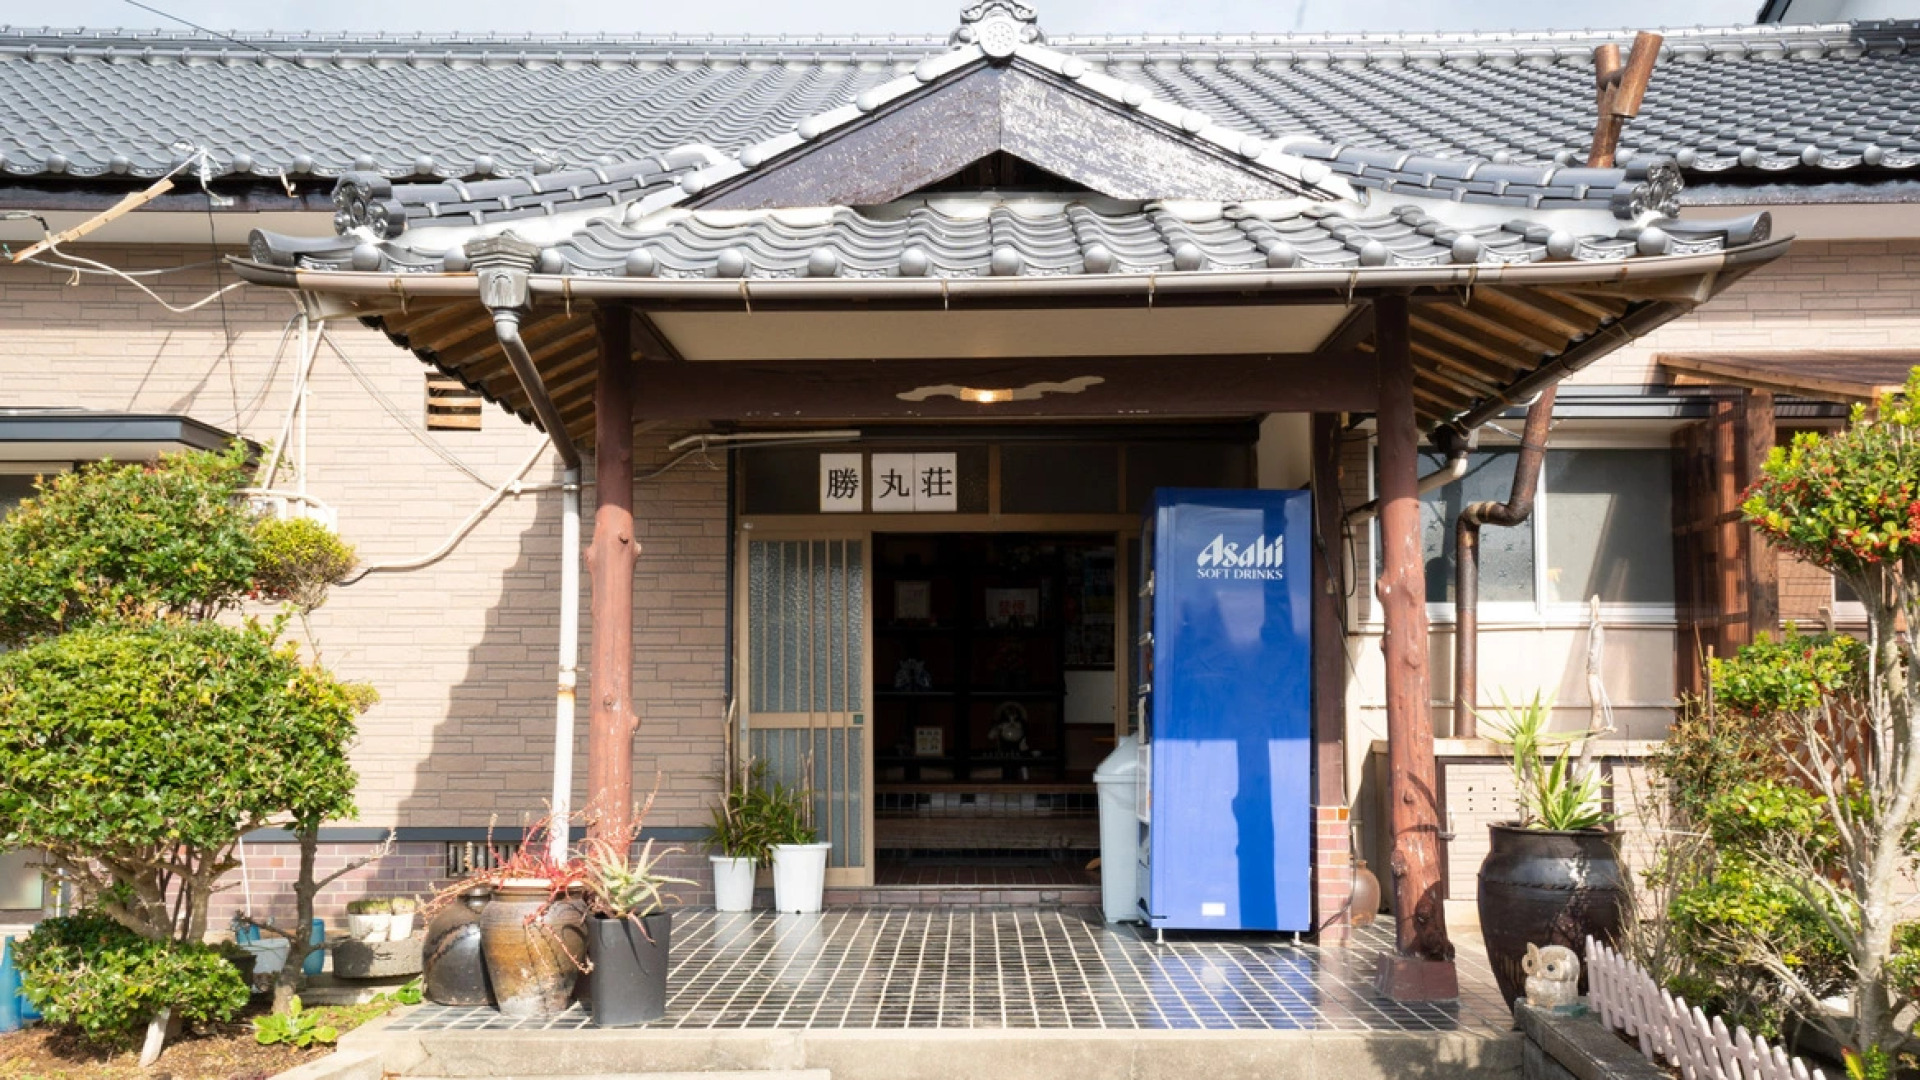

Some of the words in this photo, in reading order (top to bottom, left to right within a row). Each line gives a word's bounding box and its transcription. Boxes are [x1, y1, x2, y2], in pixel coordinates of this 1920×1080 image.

[826, 466, 952, 499] 勝丸荘
[1197, 533, 1283, 568] Asahi
[1197, 568, 1229, 580] SOFT
[1234, 568, 1283, 580] DRINKS
